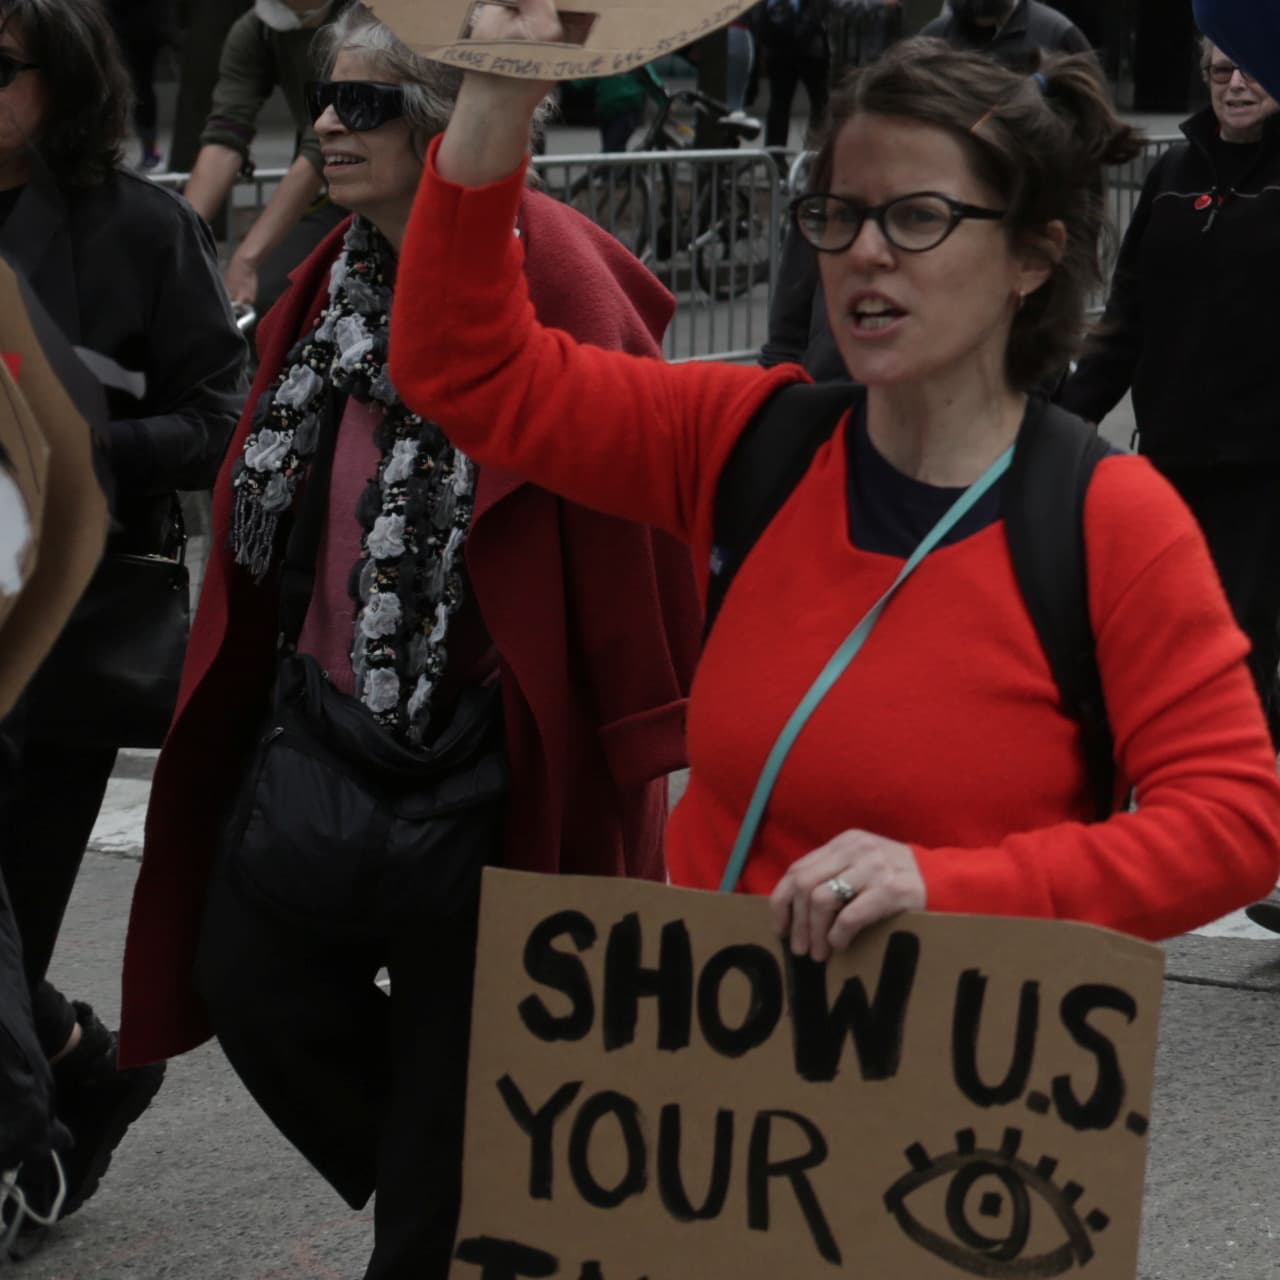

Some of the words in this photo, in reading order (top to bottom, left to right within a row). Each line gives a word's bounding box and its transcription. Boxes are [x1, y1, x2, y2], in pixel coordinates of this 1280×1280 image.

[517, 909, 920, 1082] SHOW
[952, 968, 1150, 1135] U.S.
[496, 1072, 843, 1266] YOUR
